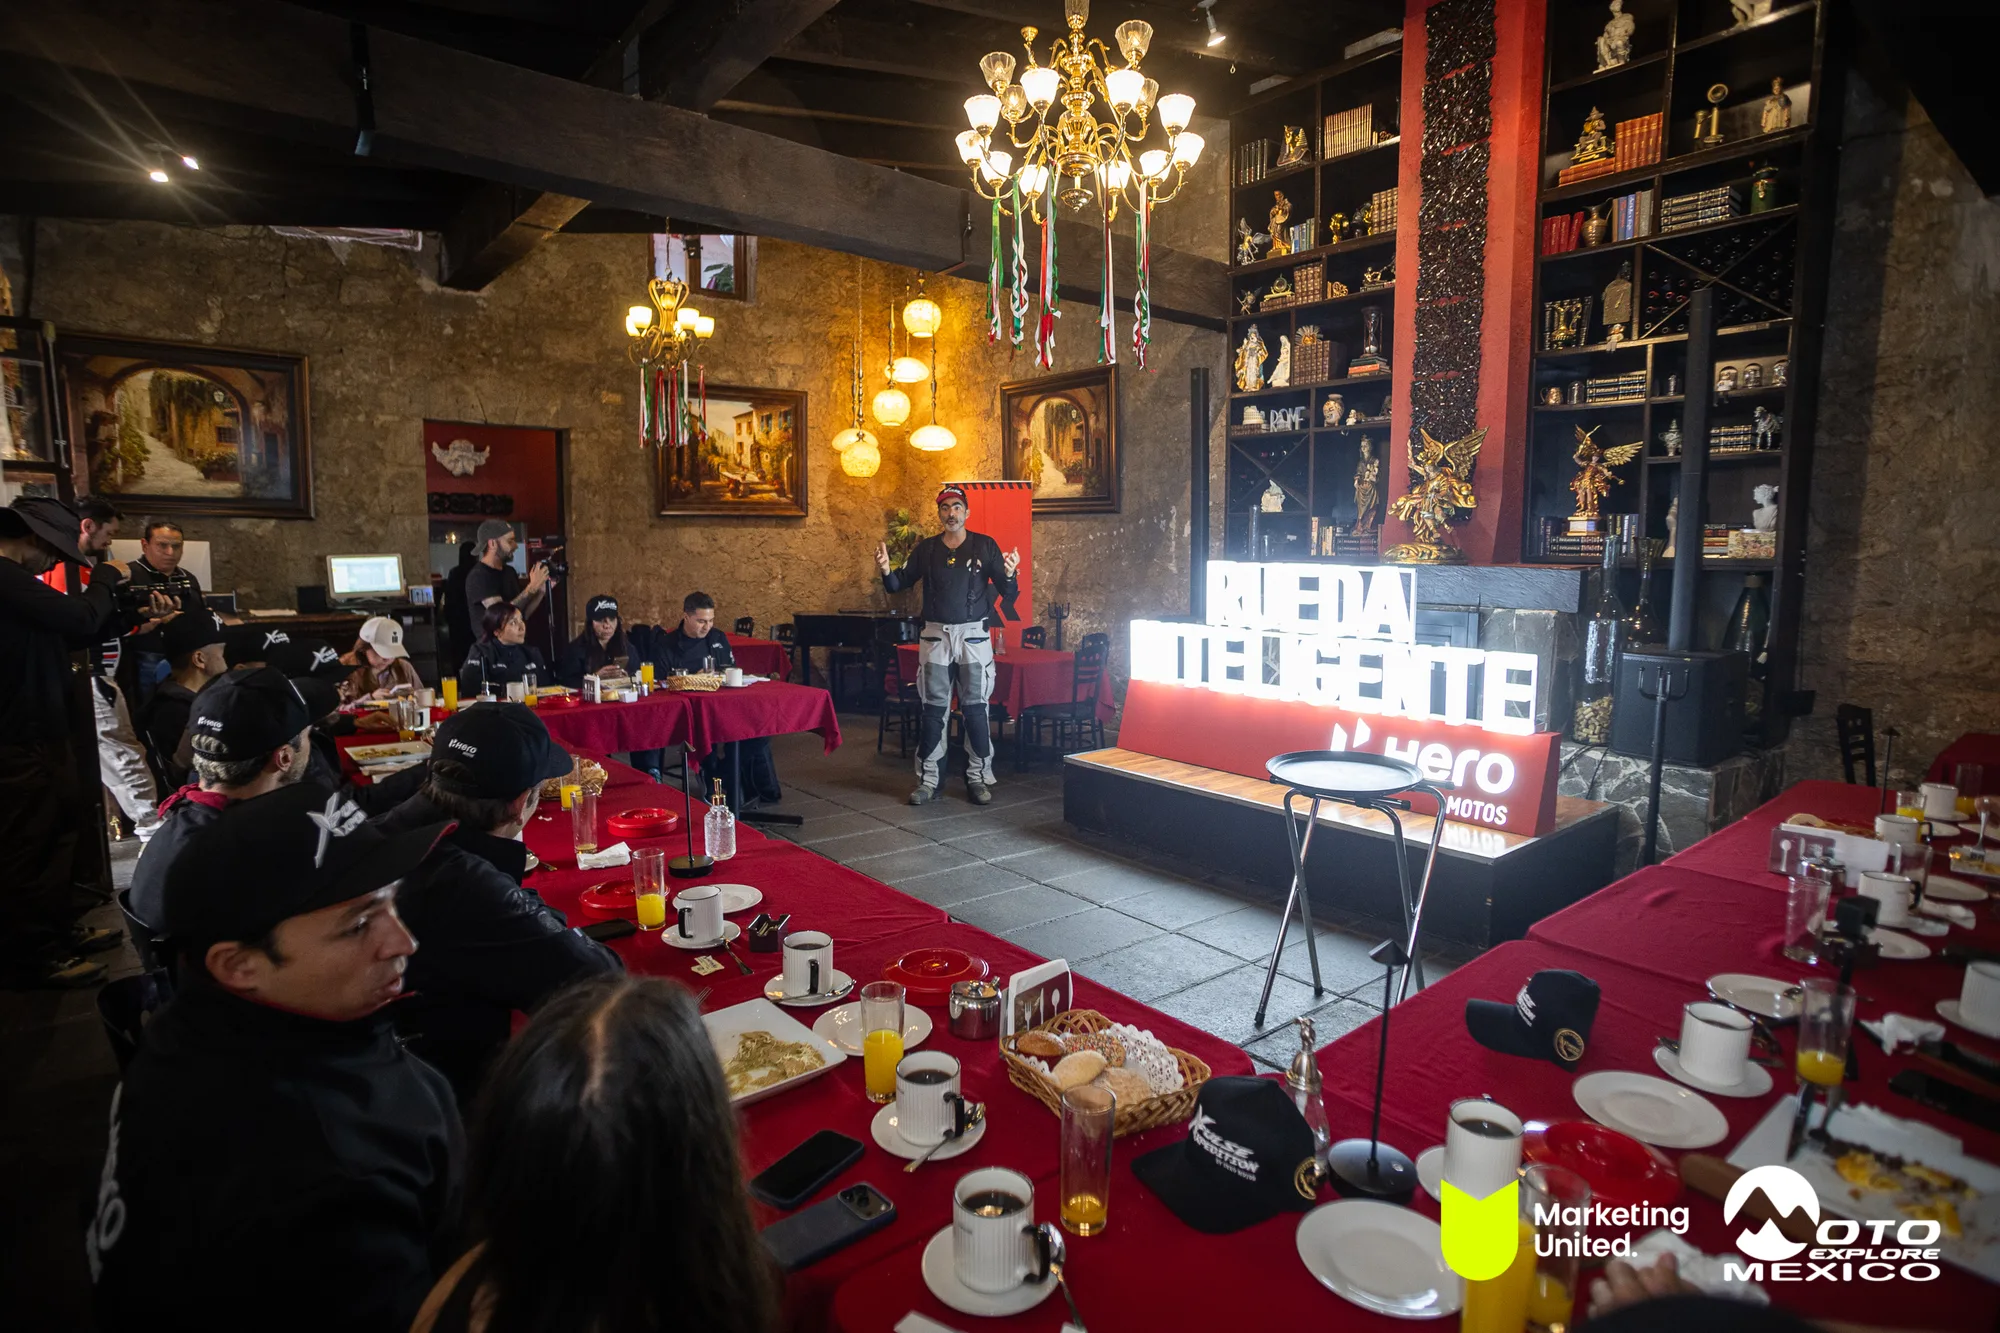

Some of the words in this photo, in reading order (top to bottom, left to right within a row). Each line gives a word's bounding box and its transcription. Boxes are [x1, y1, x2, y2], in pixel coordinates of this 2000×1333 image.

[1206, 560, 1417, 643] RUEDA
[1384, 736, 1516, 794] Hero
[1445, 795, 1509, 826] MOTOS
